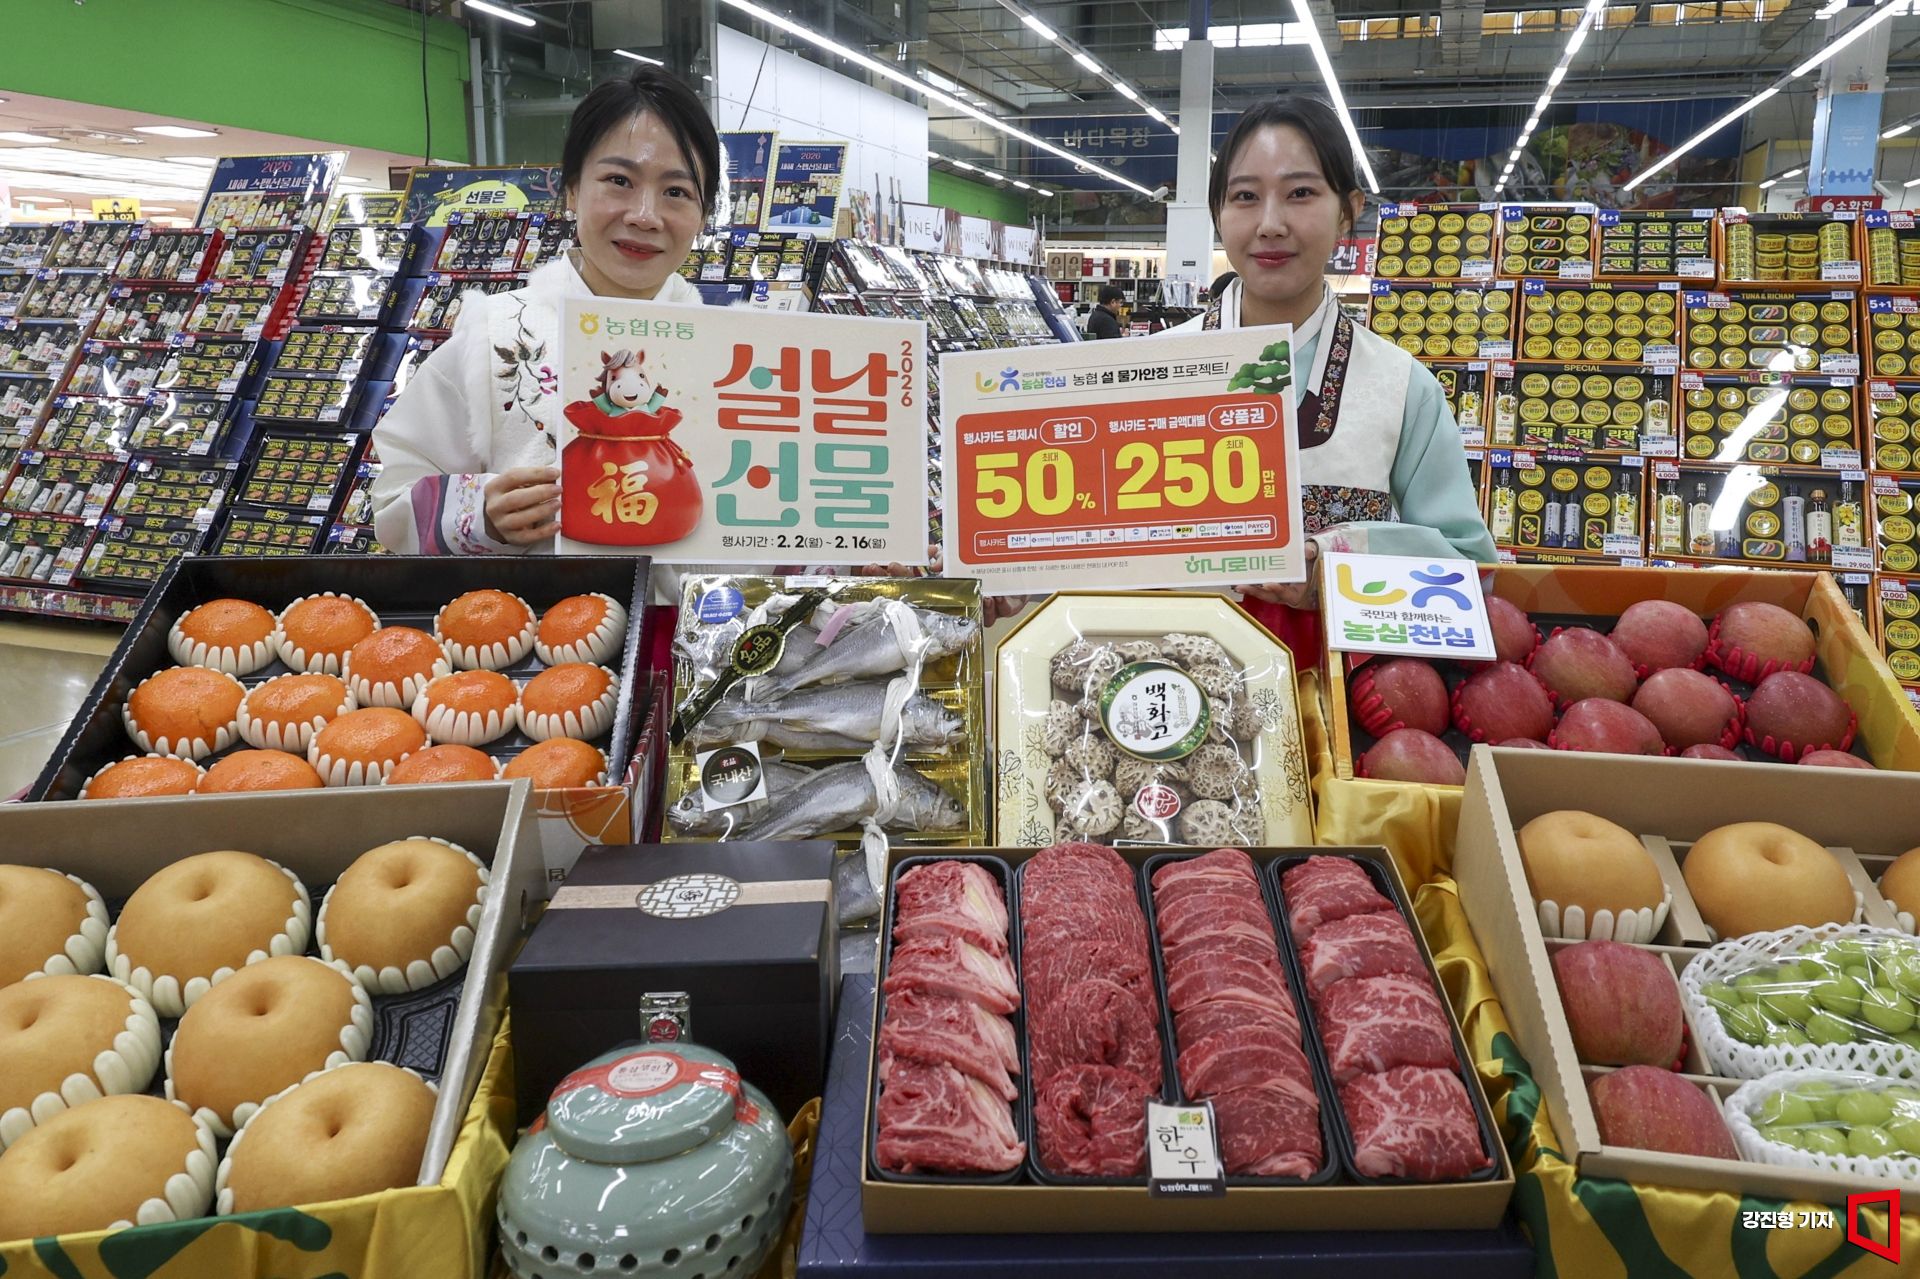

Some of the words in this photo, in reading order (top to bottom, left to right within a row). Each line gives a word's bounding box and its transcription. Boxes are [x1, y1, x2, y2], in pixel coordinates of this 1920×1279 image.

[465, 190, 507, 205] 선물은
[1428, 204, 1448, 212] TUNA
[1836, 200, 1873, 211] 소화전
[1504, 208, 1522, 218] 1+1
[1600, 214, 1618, 222] 4+1
[1866, 214, 1888, 224] 4+1
[904, 219, 931, 236] INE
[964, 230, 985, 245] WINE
[1008, 238, 1028, 252] WINE
[1525, 282, 1544, 290] 5+1
[1590, 282, 1612, 290] TUNA
[1686, 295, 1707, 304] 5+1
[1869, 300, 1892, 309] 5+1
[606, 316, 695, 340] 농협유통
[900, 340, 914, 408] 2026
[1072, 372, 1098, 387] 농협
[1101, 370, 1114, 384] 설
[1117, 366, 1169, 383] 물가안정
[1172, 362, 1229, 378] 프로젝트!
[1564, 364, 1602, 372] SPECIAL
[1022, 376, 1067, 390] 농심천심
[1750, 372, 1792, 384] BEST
[713, 343, 899, 437] 설날
[1219, 407, 1266, 426] 상품권
[1053, 422, 1082, 439] 할인
[1108, 419, 1146, 434] 행사카드
[1148, 416, 1166, 430] 구매
[1168, 414, 1206, 429] 금액대별
[963, 429, 1004, 445] 행사카드
[1006, 426, 1037, 443] 결제시
[1528, 426, 1554, 438] 리챔
[1568, 428, 1594, 439] 리챔
[1609, 430, 1635, 440] 리챔
[1226, 439, 1244, 450] 최대
[1042, 452, 1059, 462] 최대
[1490, 454, 1510, 463] 10+1
[1115, 435, 1260, 510] 250
[712, 439, 894, 530] 선물
[1262, 470, 1276, 499] 만원
[587, 460, 660, 526] 福
[264, 510, 288, 521] BEST
[722, 536, 768, 548] 행사기간
[979, 538, 1006, 547] 행사카드
[1185, 556, 1286, 574] 하나로마트
[1537, 554, 1575, 563] PREMIUM
[1360, 608, 1397, 620] 국민과
[1400, 612, 1453, 624] 함께하는
[1344, 620, 1476, 648] 농심천심
[1146, 682, 1172, 740] 백화고
[710, 766, 752, 788] 국내산
[1156, 1125, 1206, 1174] 한우
